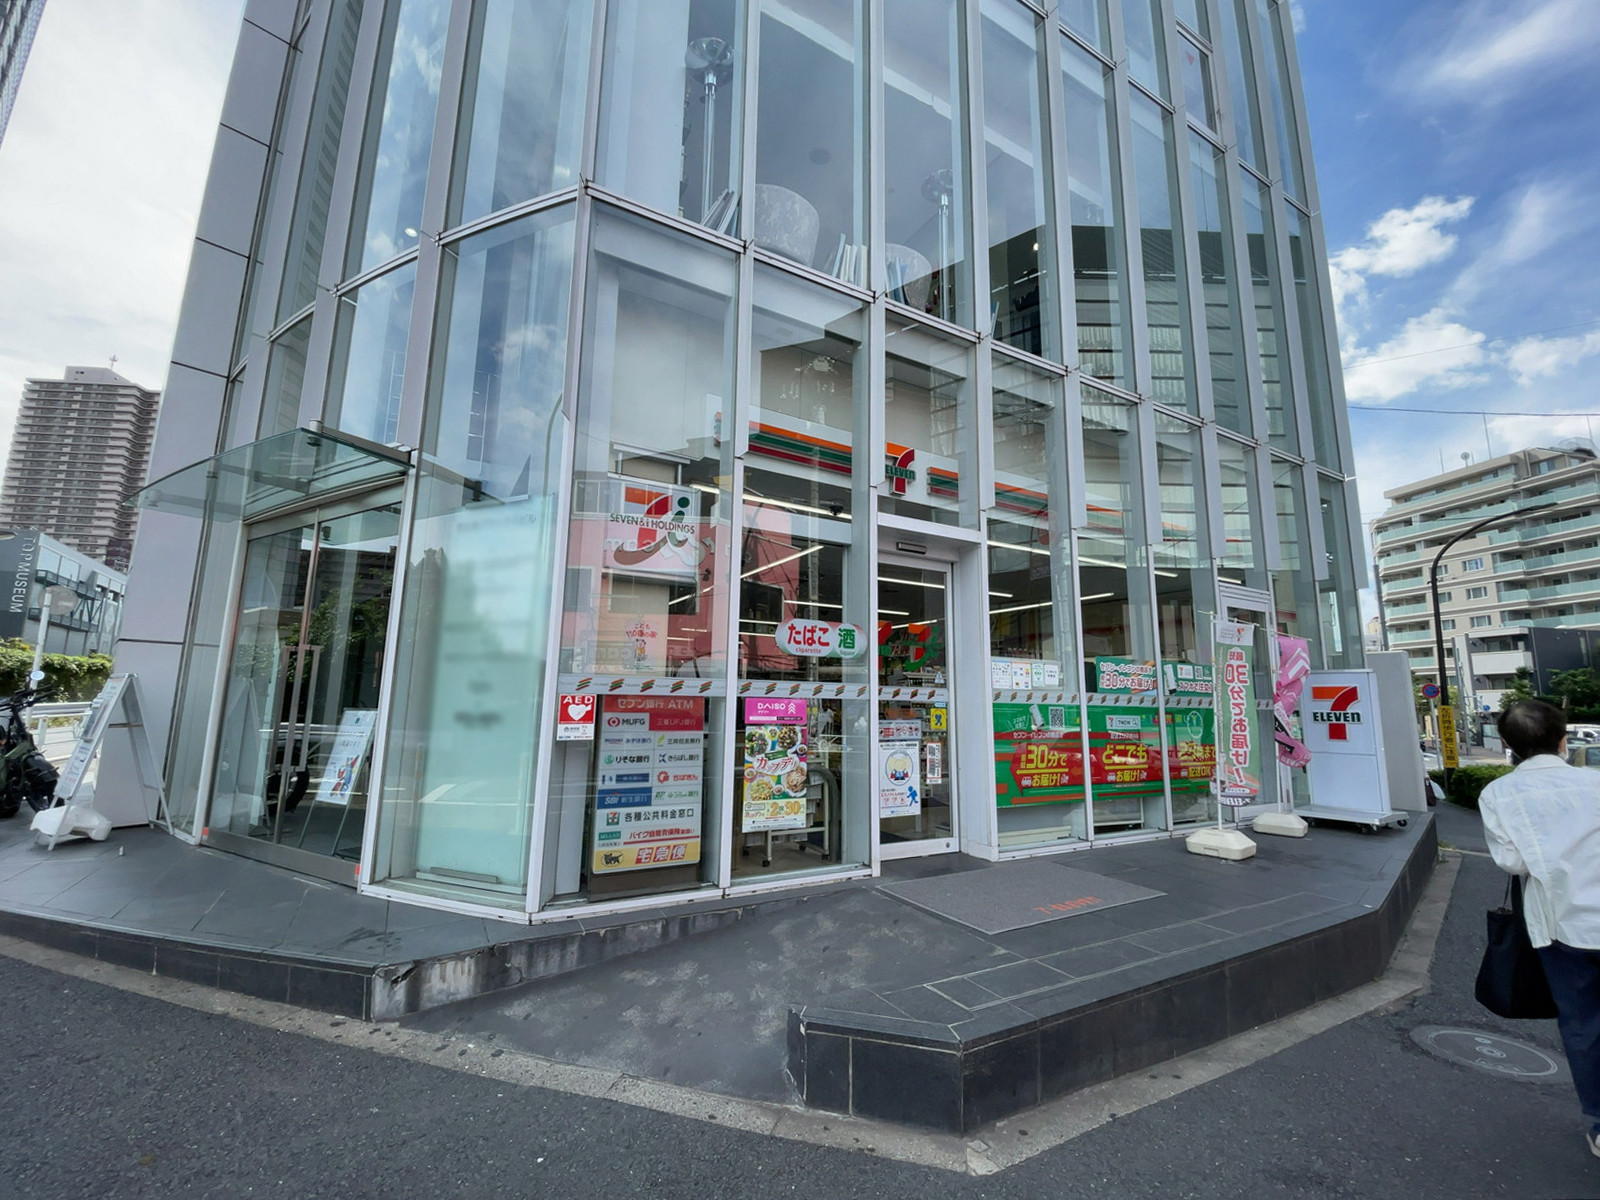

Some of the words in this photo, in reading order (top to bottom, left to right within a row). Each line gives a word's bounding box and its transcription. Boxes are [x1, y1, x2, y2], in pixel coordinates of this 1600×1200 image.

[651, 519, 696, 534] HOLDINGS
[9, 561, 31, 613] MUSEUM
[787, 623, 830, 647] たばこ
[838, 627, 856, 649] 酒
[562, 695, 594, 704] AED
[617, 698, 665, 709] セブン銀行
[667, 699, 694, 709] ATM
[757, 702, 786, 710] DAISO
[621, 718, 646, 726] MUFG
[615, 755, 650, 763] りそな銀行
[1102, 744, 1148, 764] どこでも
[604, 796, 620, 805] SBI
[624, 808, 695, 823] 各種公共料金窓口
[637, 844, 688, 864] 宅急便
